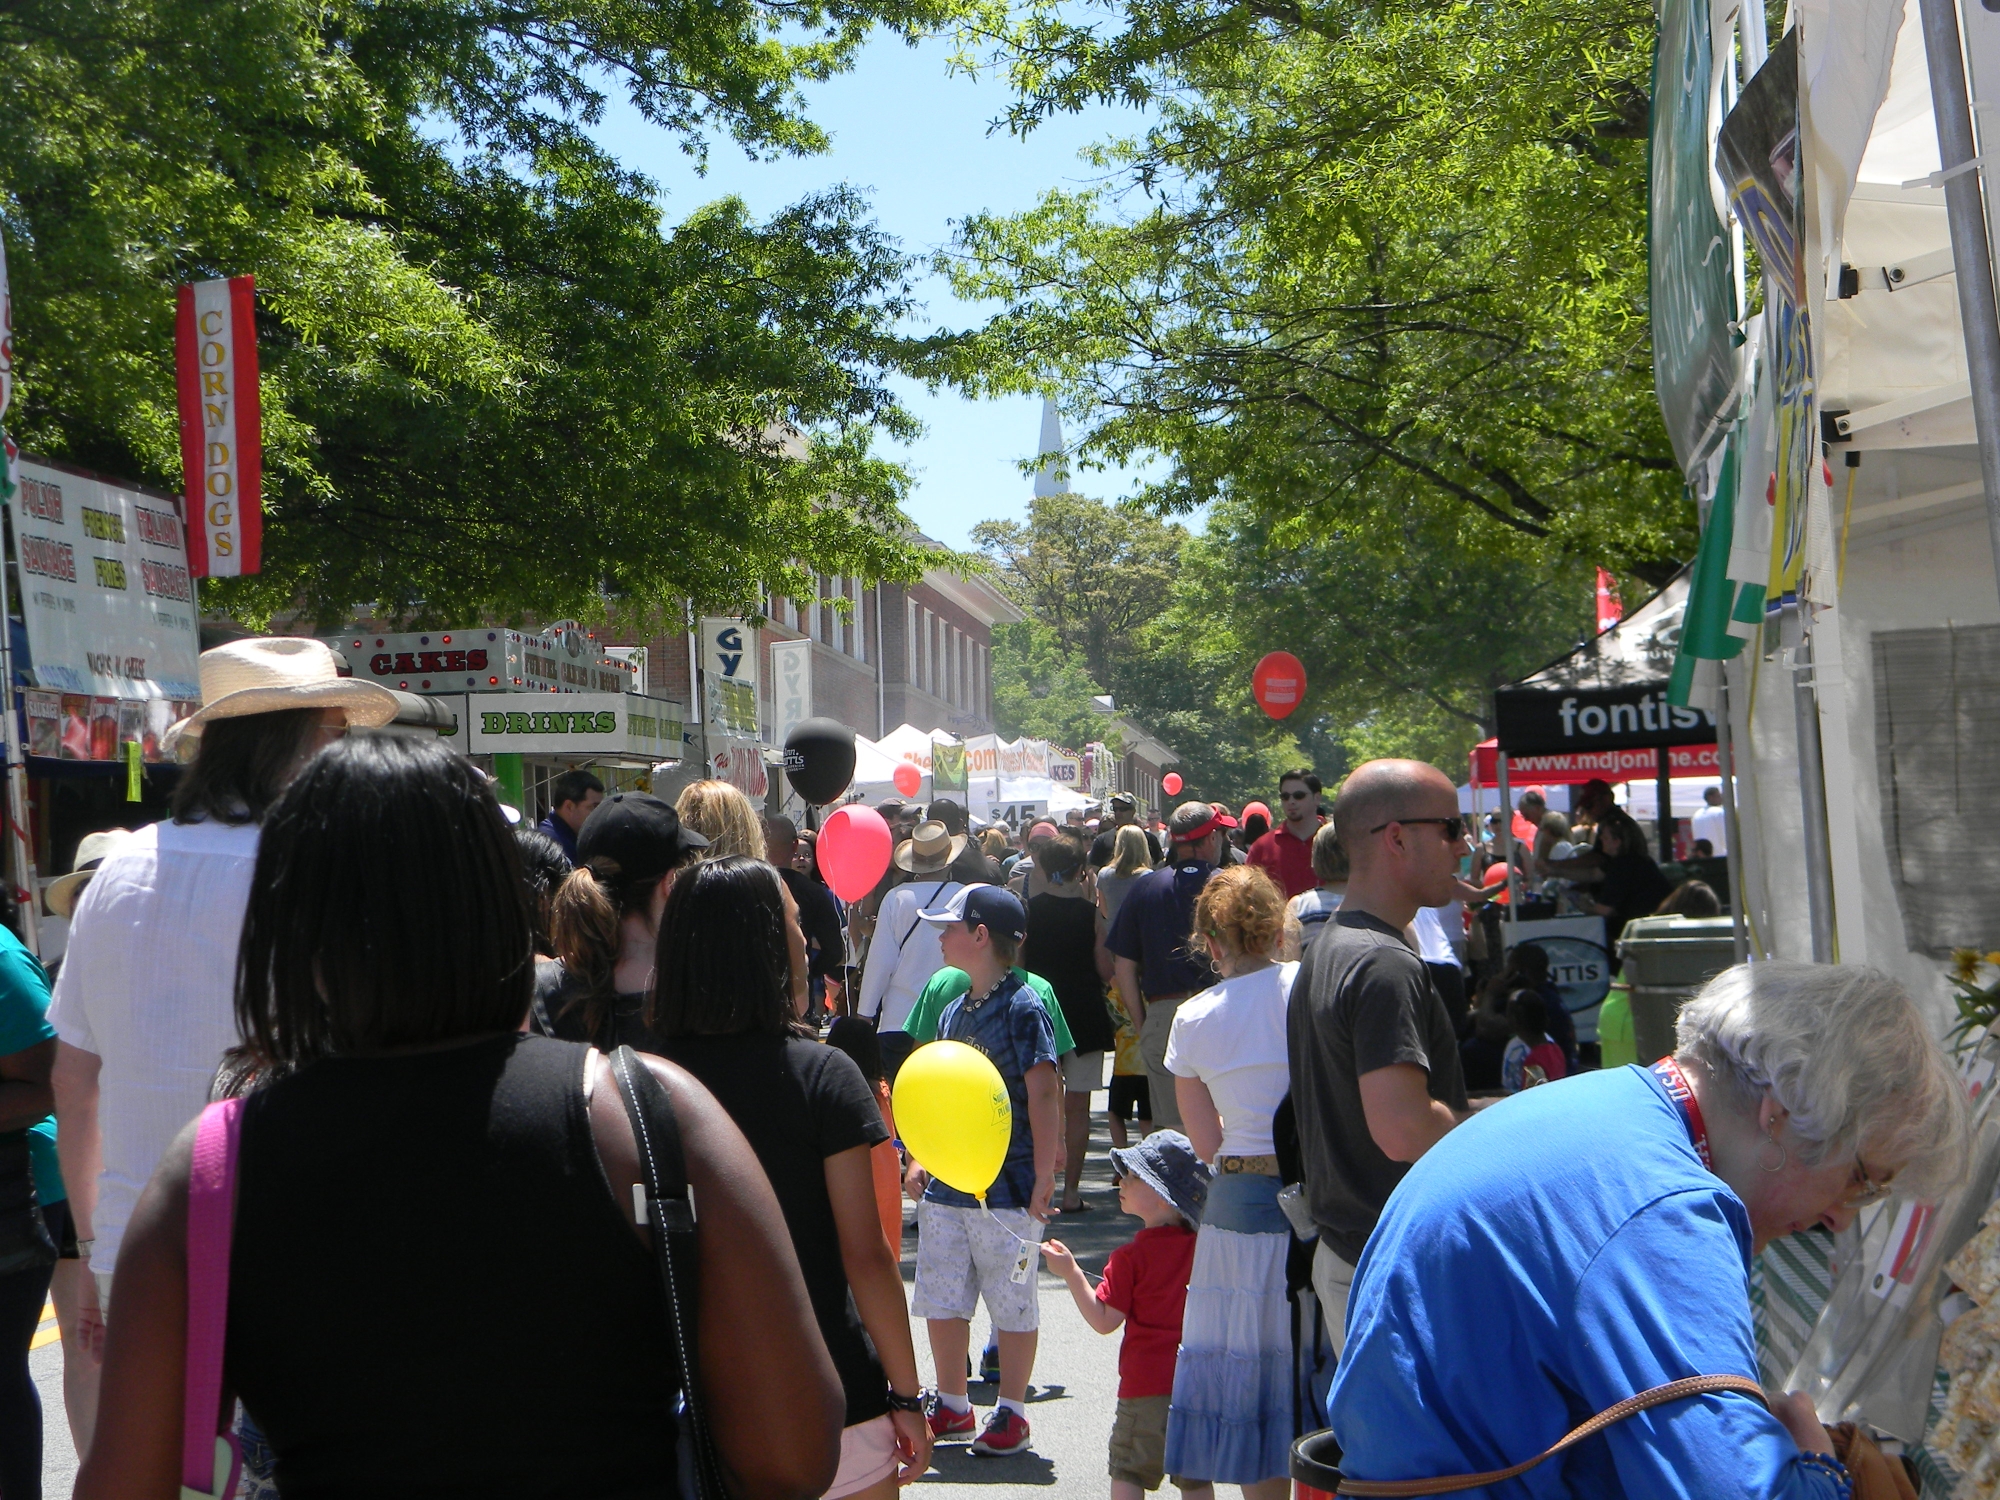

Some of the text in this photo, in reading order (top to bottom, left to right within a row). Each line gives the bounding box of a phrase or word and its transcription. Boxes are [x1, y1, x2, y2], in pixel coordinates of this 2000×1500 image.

[200, 310, 234, 557] CORN DOGS
[20, 475, 64, 525] POLISH
[81, 506, 126, 544] FRENCH
[134, 505, 180, 550] ITALIAN
[21, 532, 77, 583] SAUSAGE
[93, 556, 127, 591] FRIES
[140, 557, 190, 603] SAUSAGE
[369, 649, 489, 676] CAKES
[524, 652, 557, 680] FUNNEL
[599, 670, 620, 693] MORE
[481, 711, 617, 733] DRINKS
[1549, 964, 1599, 982] NTIS
[1655, 1059, 1691, 1102] USA
